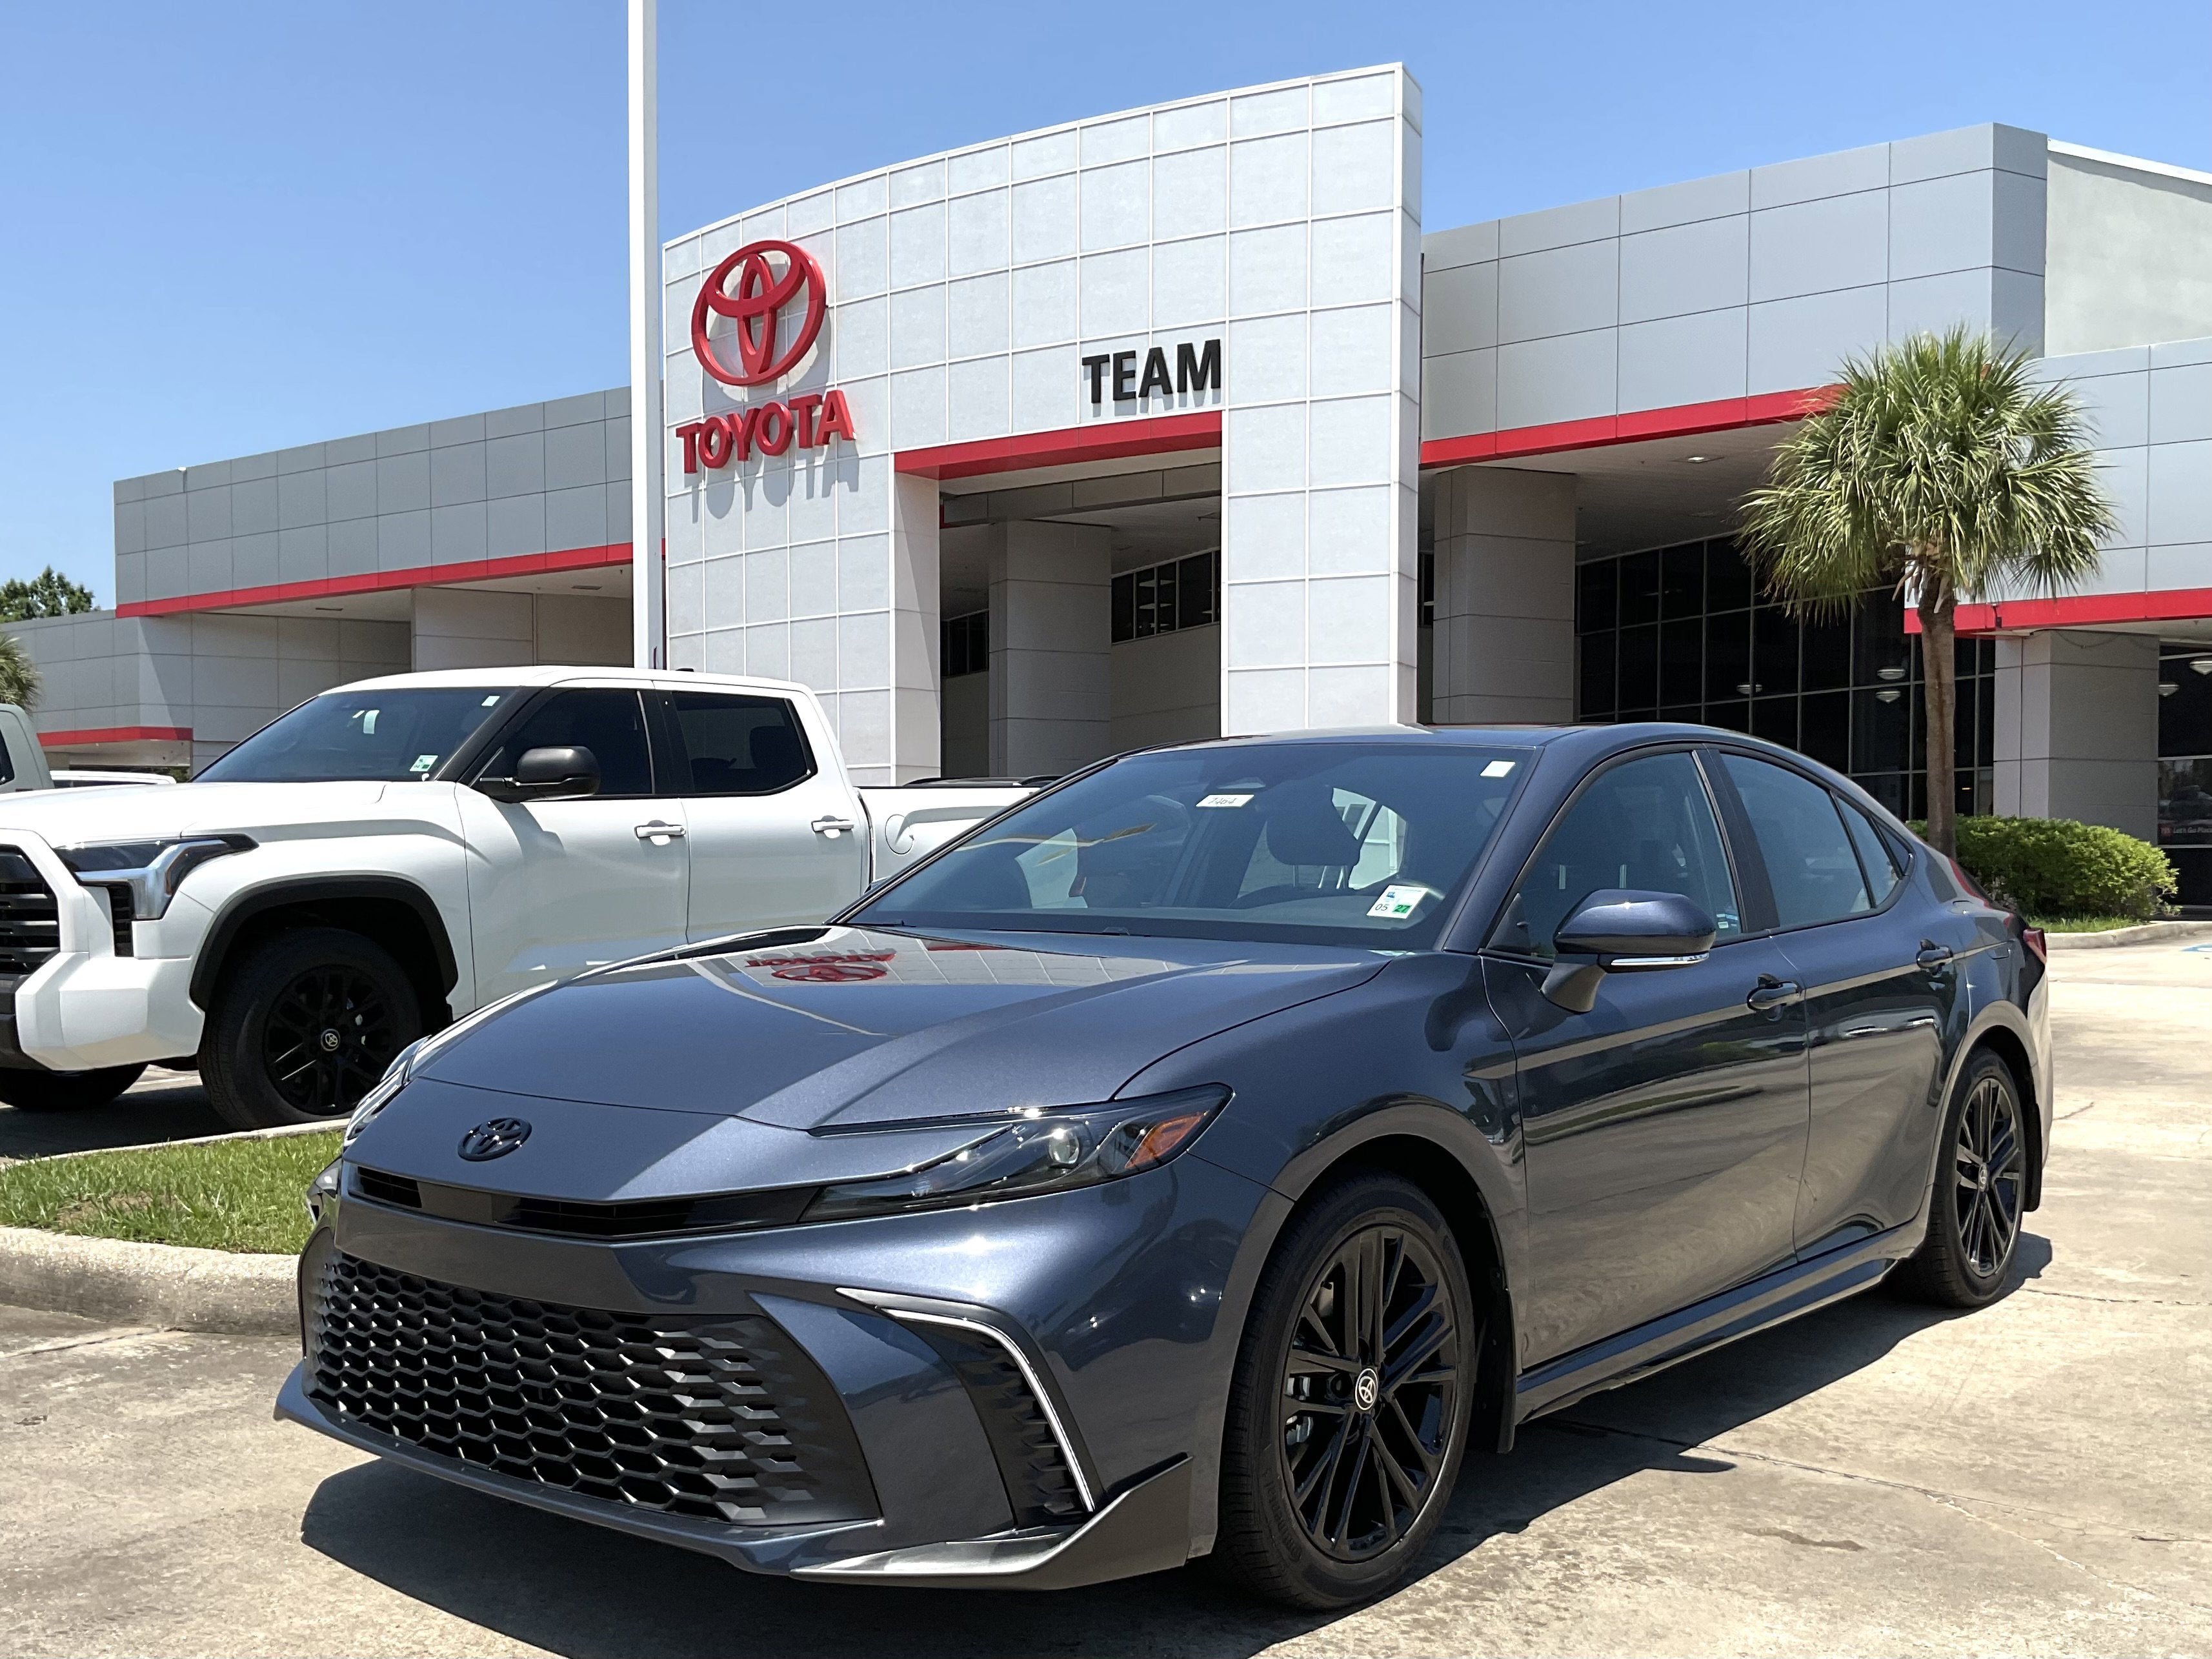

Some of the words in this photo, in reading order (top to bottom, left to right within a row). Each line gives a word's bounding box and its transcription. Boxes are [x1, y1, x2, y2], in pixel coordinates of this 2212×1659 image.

[1082, 339, 1221, 403] TEAM
[676, 390, 857, 474] TOYOTA
[1394, 905, 1411, 913] 27
